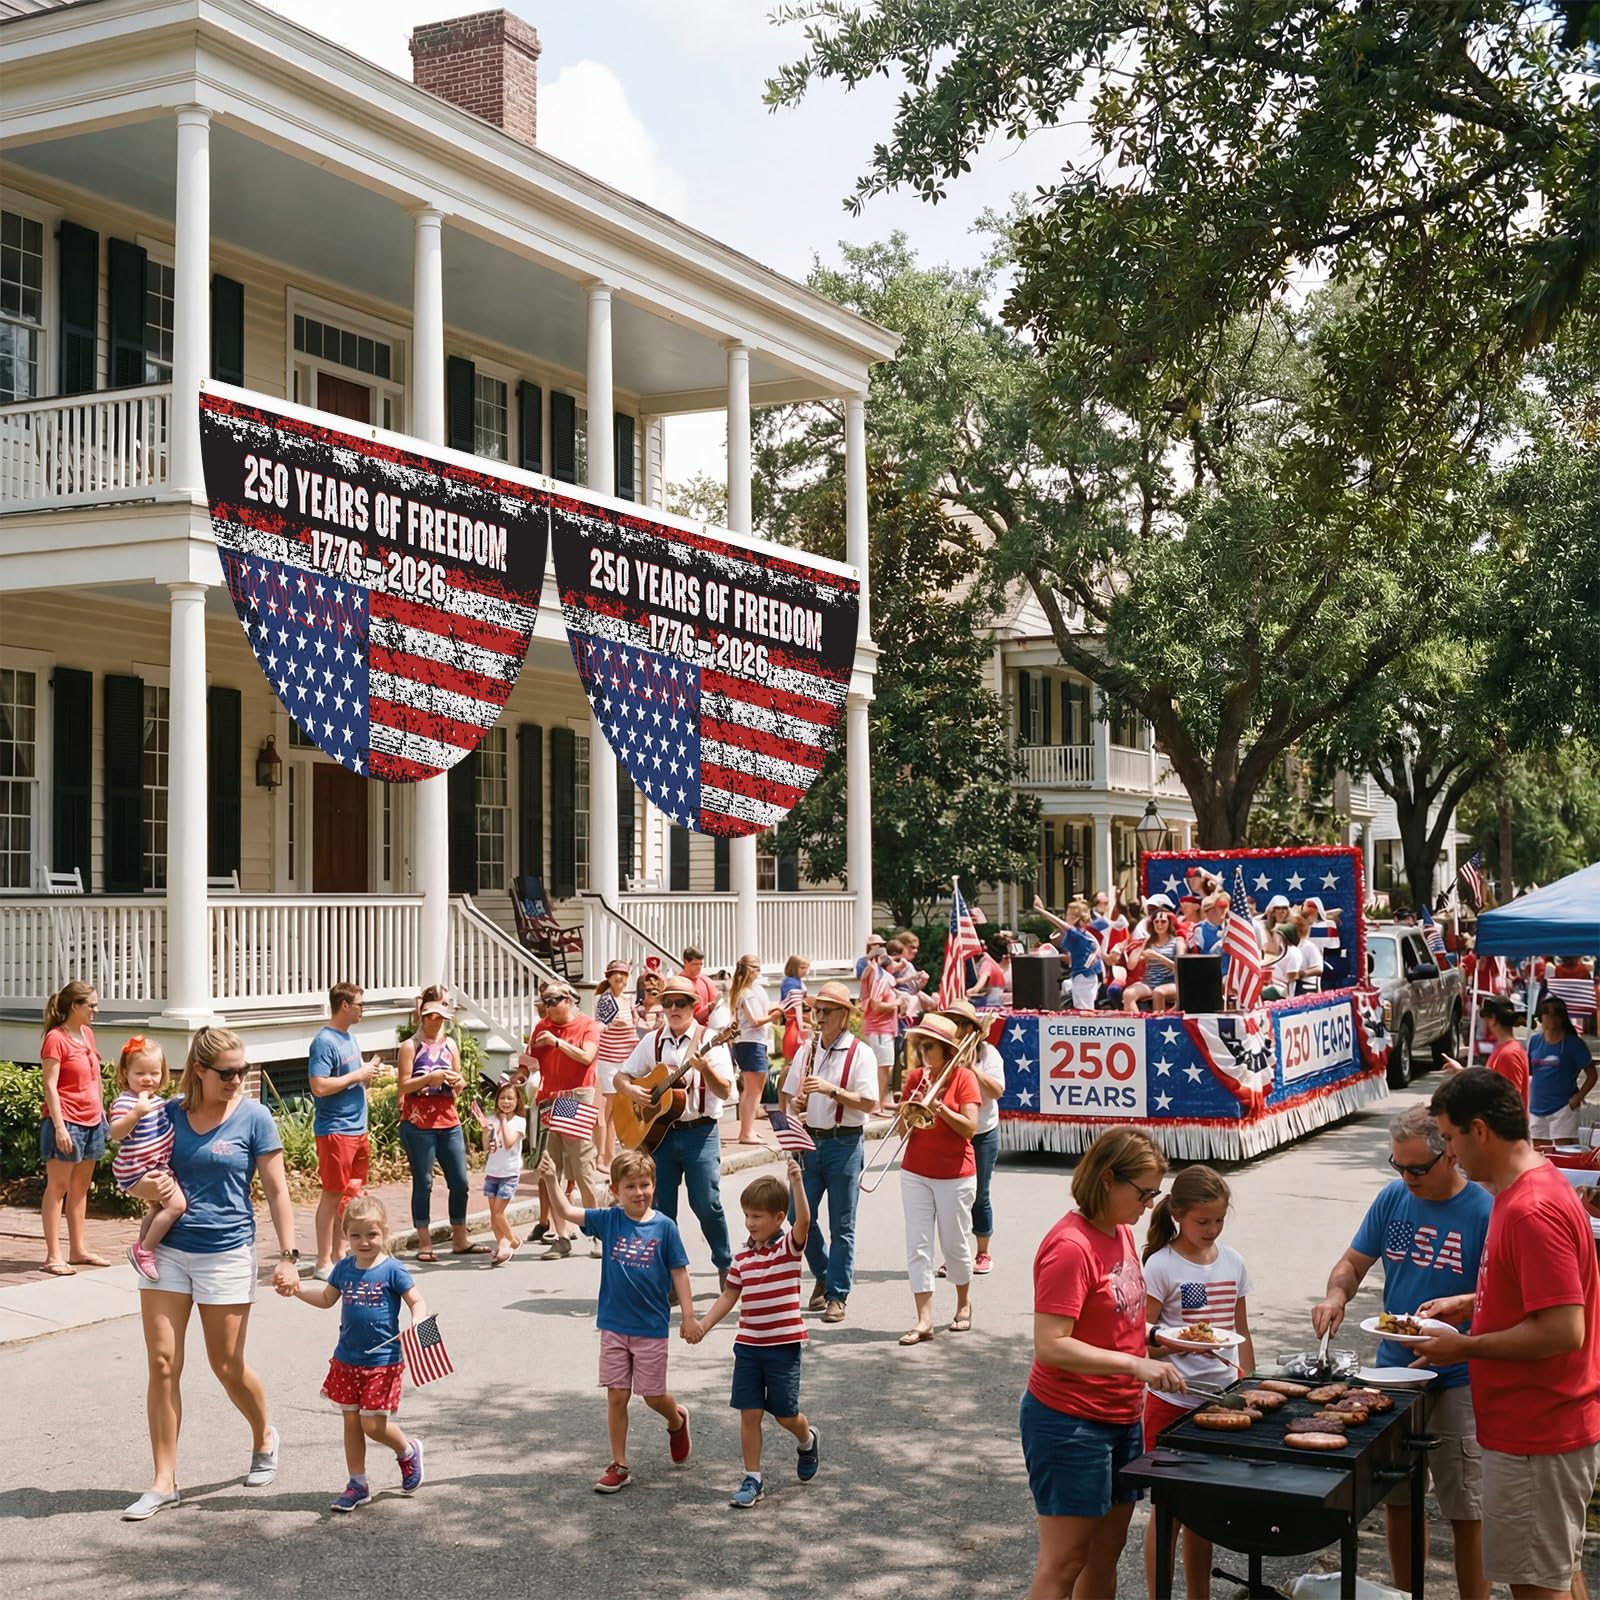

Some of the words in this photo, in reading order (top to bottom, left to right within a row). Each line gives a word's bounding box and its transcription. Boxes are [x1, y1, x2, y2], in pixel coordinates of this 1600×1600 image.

[244, 454, 289, 509] 250
[295, 467, 369, 532] YEARS
[375, 492, 402, 541] OF
[407, 500, 507, 573] FREEDOM
[311, 530, 363, 579] 1776
[387, 551, 446, 602] 2026
[590, 547, 630, 596] 250
[635, 559, 700, 617] YEARS
[705, 581, 730, 624] OF
[734, 588, 823, 653] FREEDOM
[649, 614, 695, 658] 1776
[716, 633, 769, 679] 2026
[1048, 1025, 1136, 1037] CELEBRATING
[1285, 1024, 1310, 1068] 250
[1313, 1014, 1351, 1059] YEARS
[1049, 1041, 1137, 1081] 250
[1049, 1085, 1137, 1108] YEARS
[1385, 1220, 1464, 1275] USA
